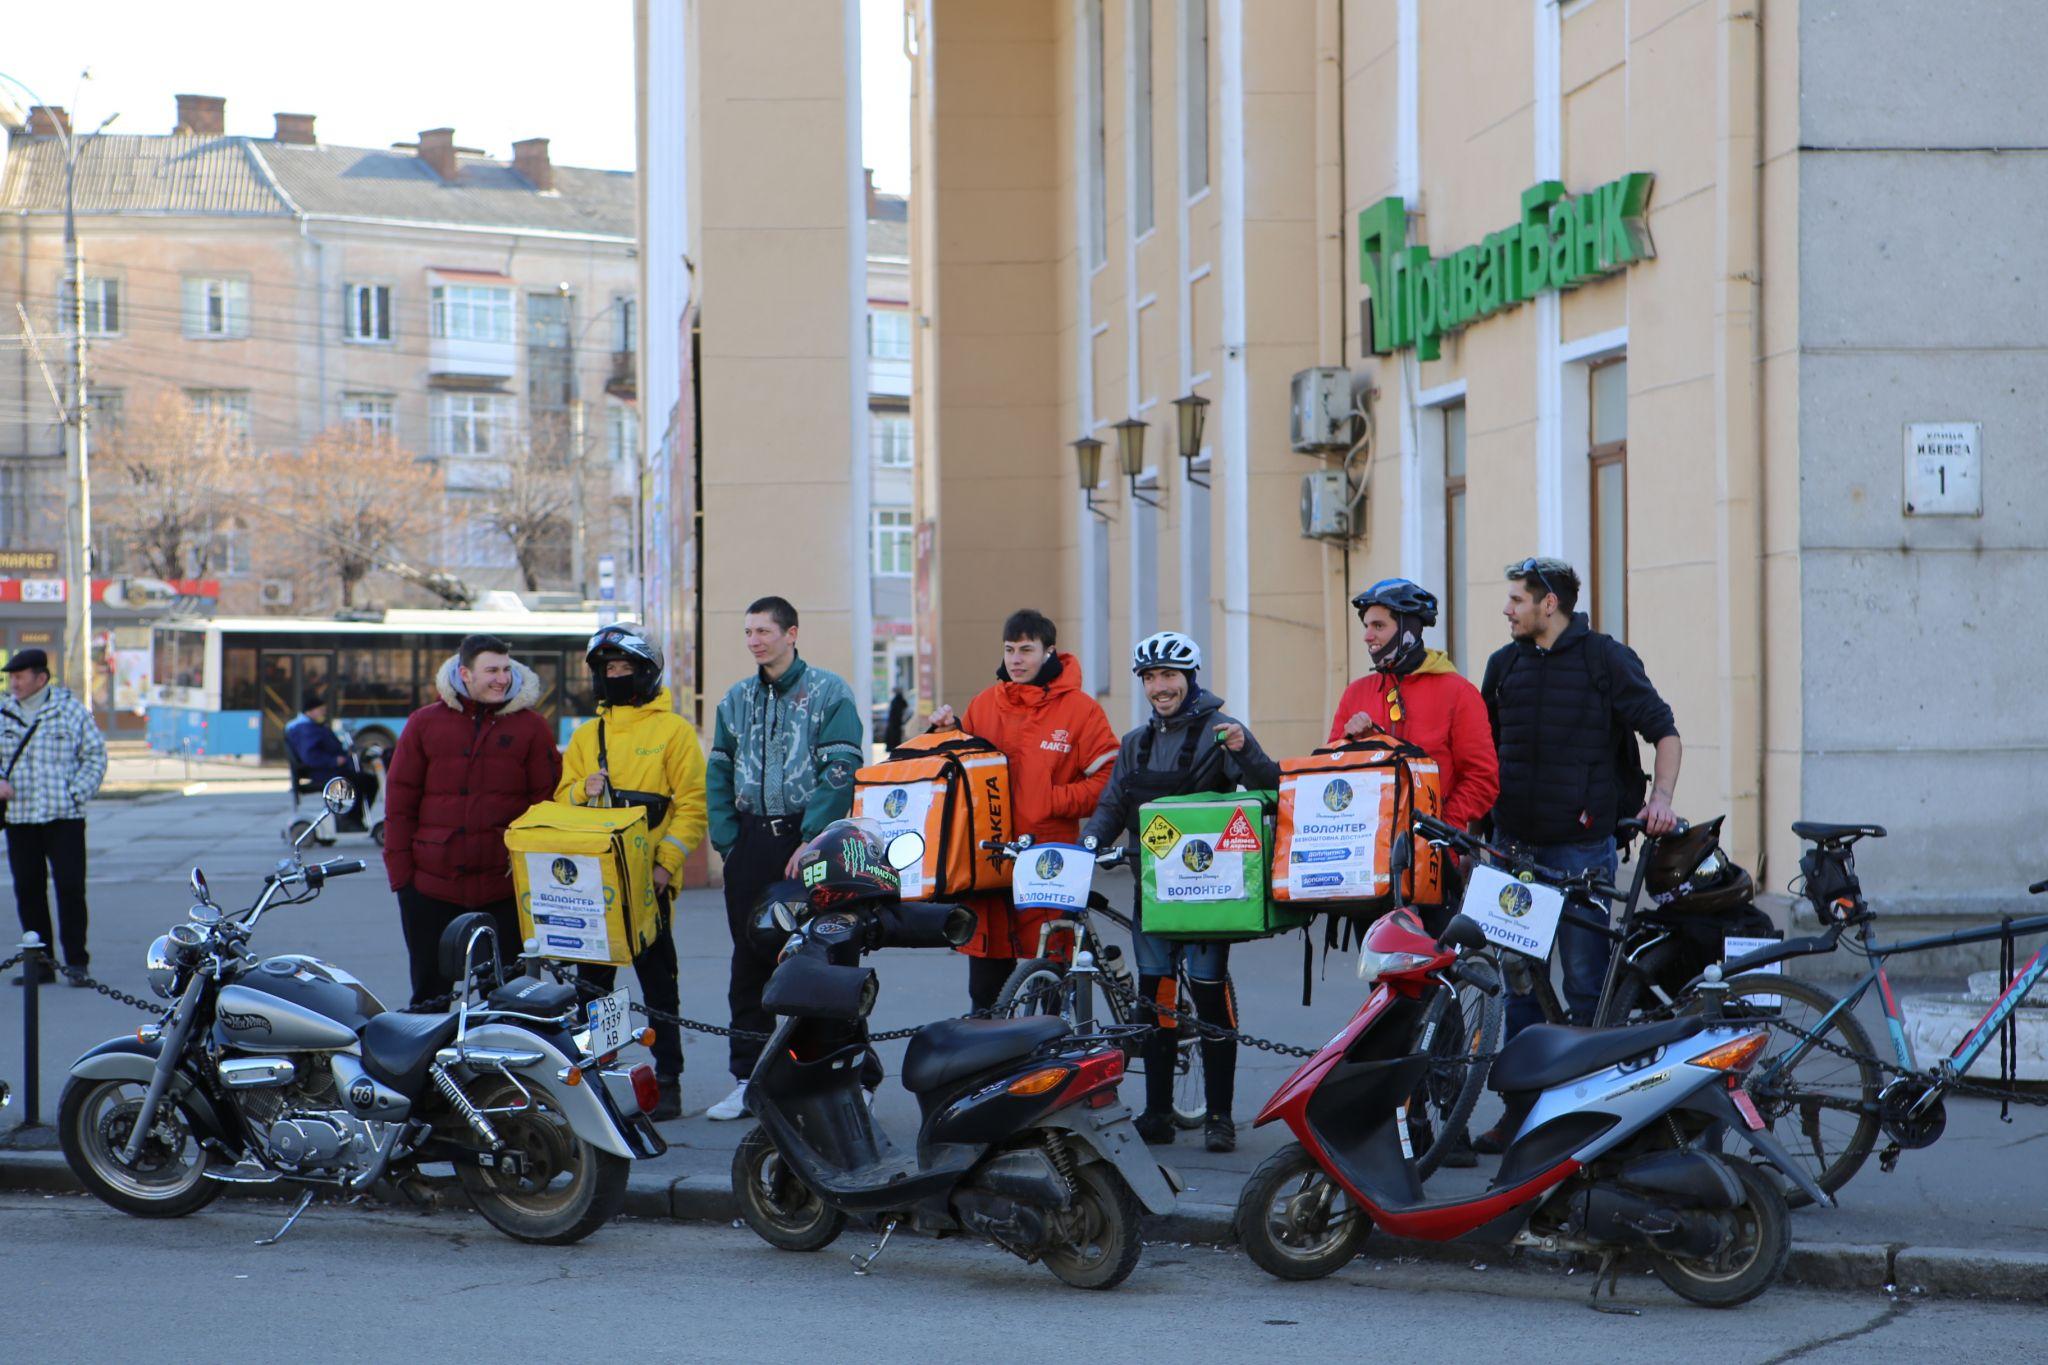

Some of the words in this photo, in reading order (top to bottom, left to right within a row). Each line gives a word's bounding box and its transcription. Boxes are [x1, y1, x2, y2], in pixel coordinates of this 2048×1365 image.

[1389, 172, 1656, 361] ПриватБанк
[1937, 464, 1945, 495] 1
[1302, 822, 1367, 834] ВОЛОНТЕР
[802, 860, 827, 888] 99
[1019, 891, 1075, 905] ВОЛОНТЕР
[1167, 884, 1232, 897] ВОЛОНТЕР
[600, 1011, 622, 1033] 1339
[351, 1086, 371, 1103] 76
